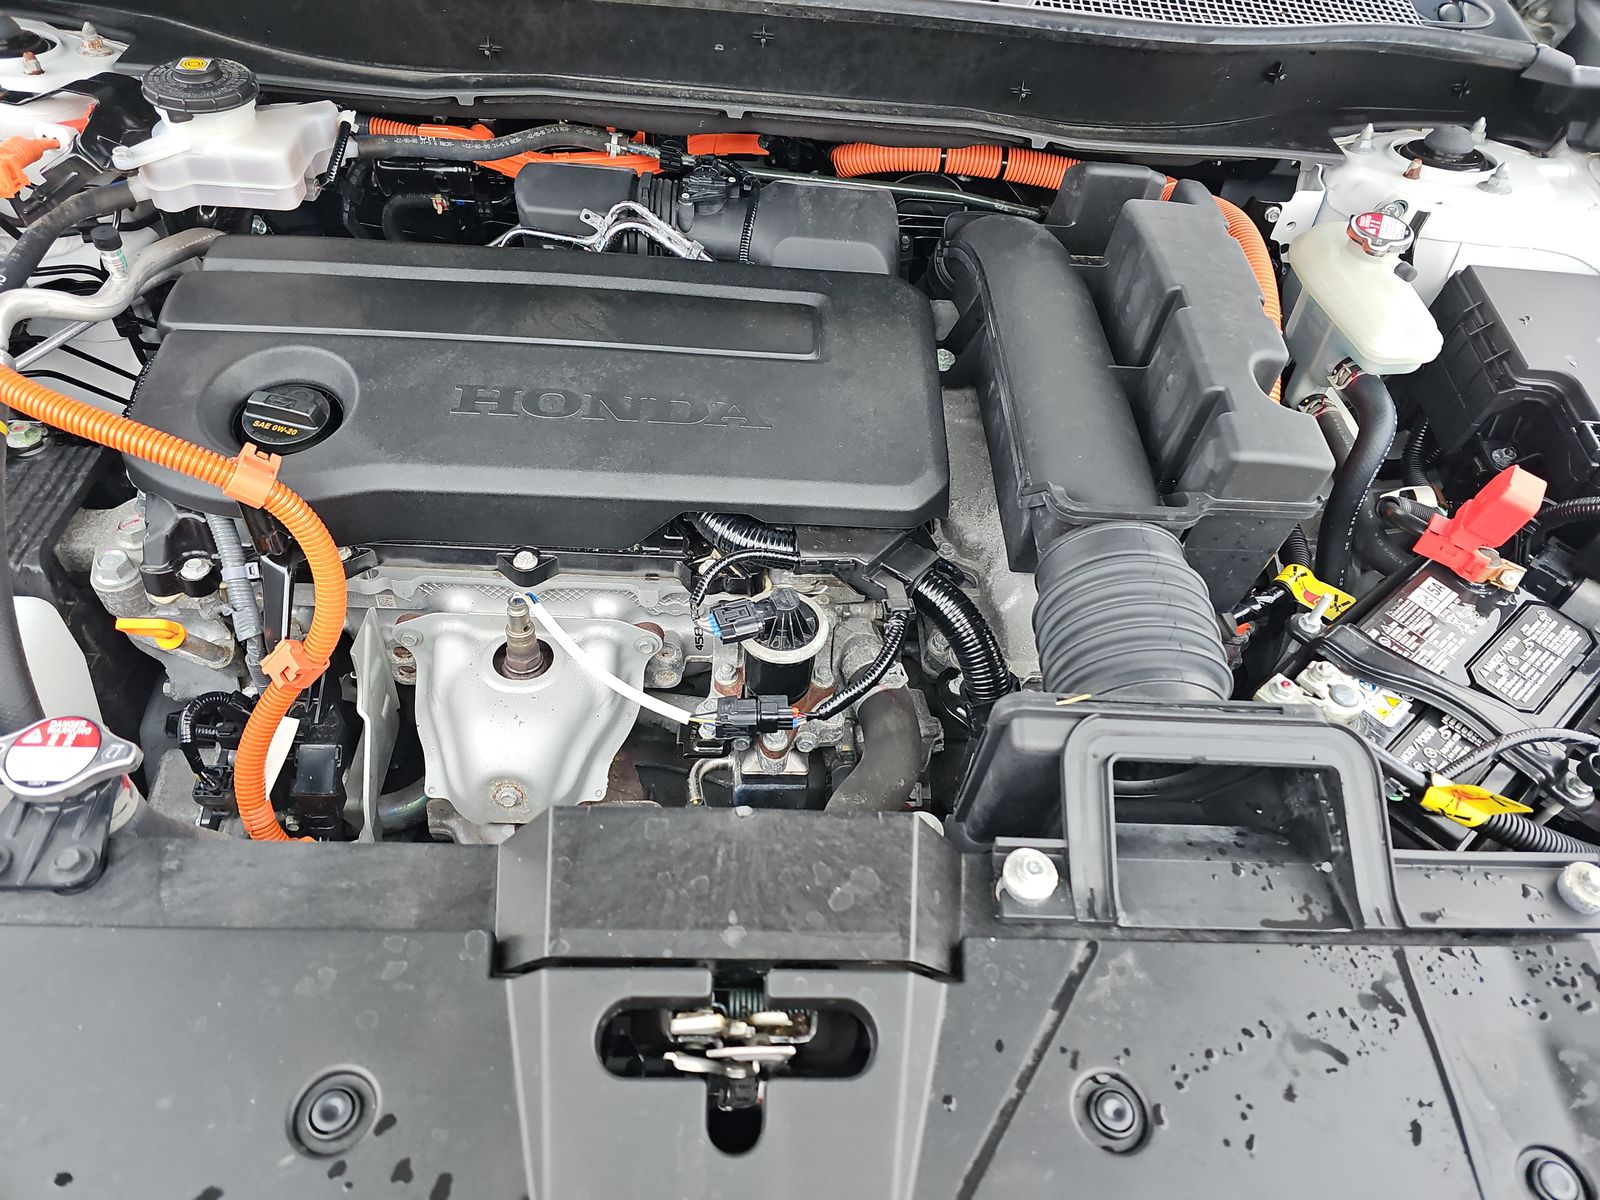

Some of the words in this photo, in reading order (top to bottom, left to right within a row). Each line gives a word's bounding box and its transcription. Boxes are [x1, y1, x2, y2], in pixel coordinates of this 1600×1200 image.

[450, 384, 773, 429] HONDA
[252, 420, 272, 430] SAE
[271, 424, 298, 436] 0W-20
